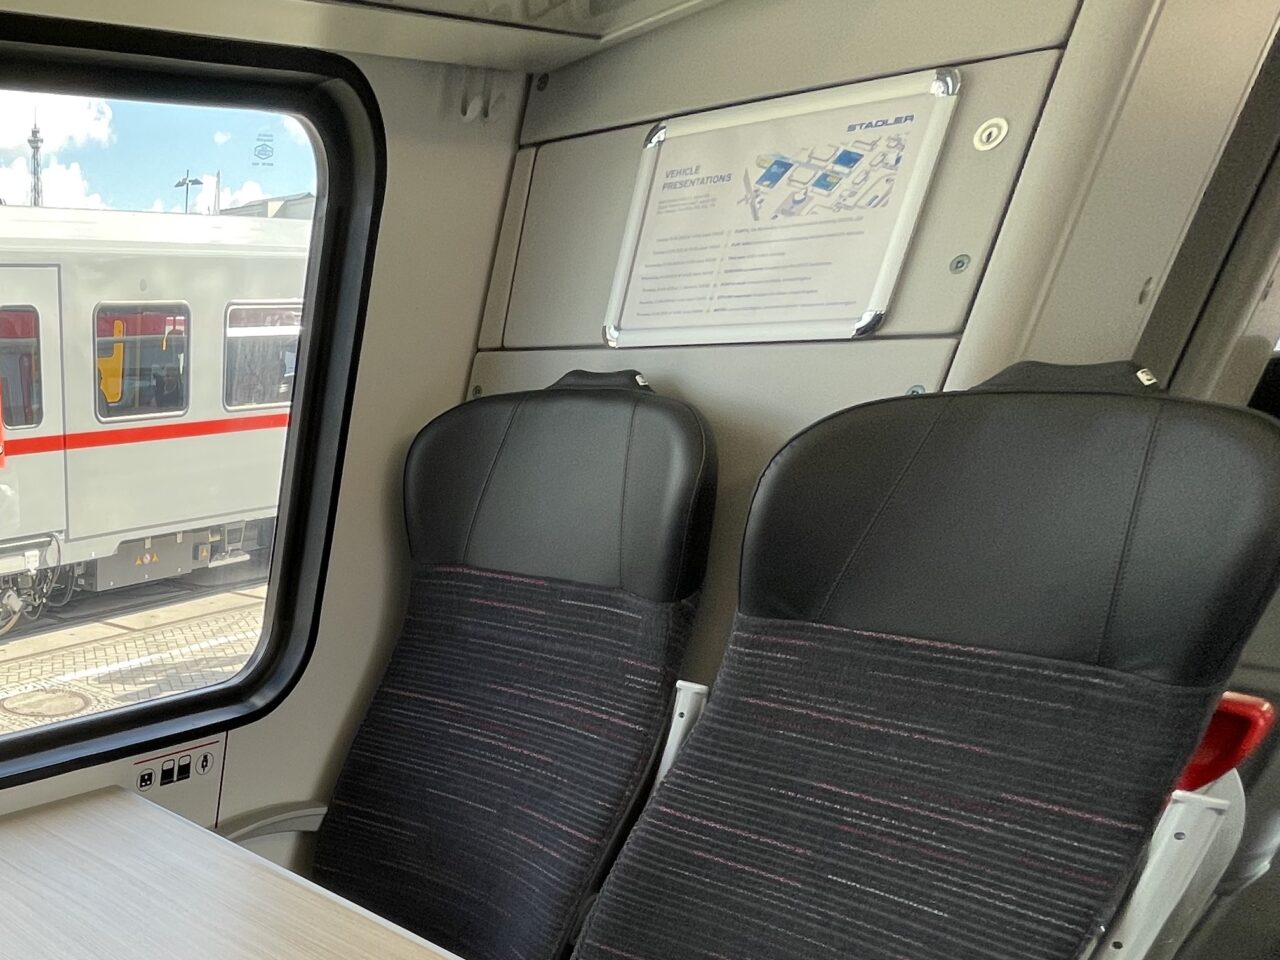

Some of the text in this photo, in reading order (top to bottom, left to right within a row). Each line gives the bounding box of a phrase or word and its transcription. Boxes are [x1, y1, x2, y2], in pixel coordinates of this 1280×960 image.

[847, 114, 914, 132] STADLER
[665, 165, 700, 179] VEHICLE
[662, 173, 732, 191] PRESENTATIONS
